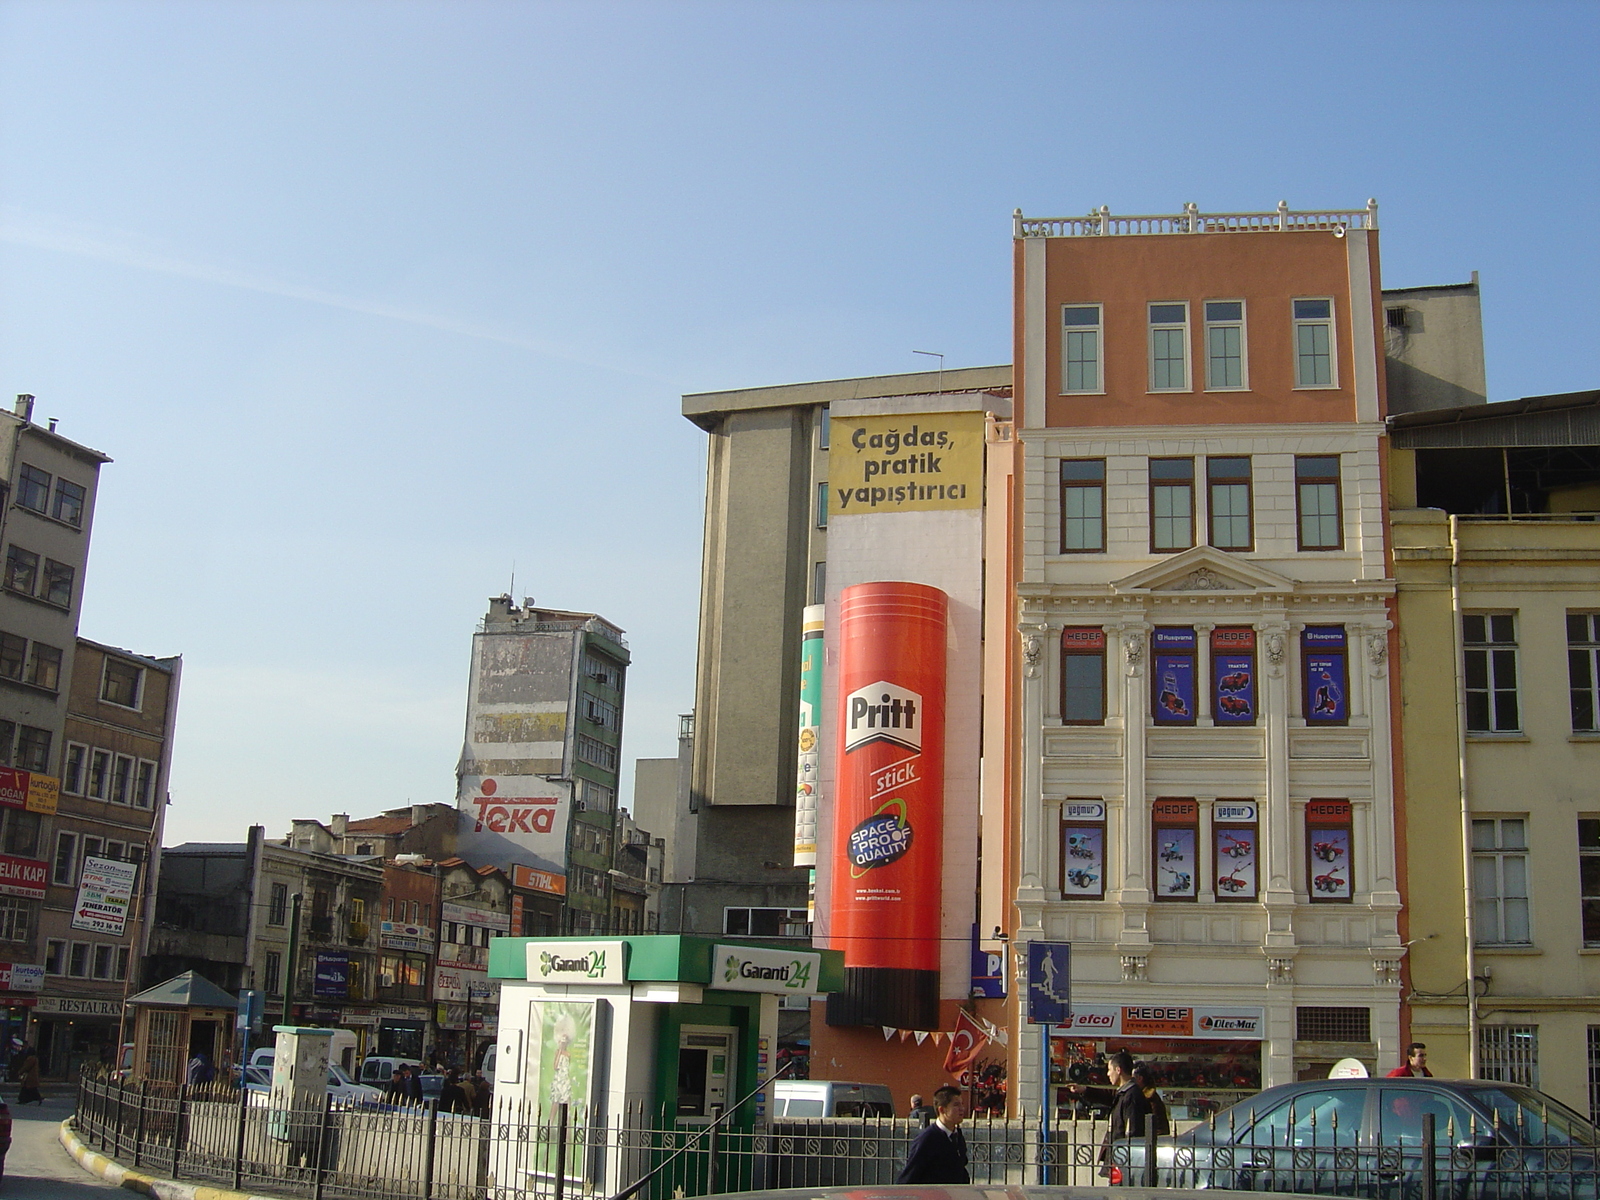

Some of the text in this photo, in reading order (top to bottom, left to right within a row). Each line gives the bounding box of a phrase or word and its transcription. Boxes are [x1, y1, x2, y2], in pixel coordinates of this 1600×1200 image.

[851, 425, 954, 455] Çağdaş,
[864, 452, 942, 482] pratik
[837, 481, 966, 508] yapıştırıcı
[1067, 632, 1101, 640] HEDEF
[1216, 632, 1251, 640] HEDEF
[851, 693, 916, 730] Pritt
[876, 763, 916, 793] stick
[30, 777, 59, 793] kurtoğlu
[0, 787, 25, 800] OĞAN
[1156, 804, 1194, 815] HEDEF
[1311, 805, 1349, 815] HEDEF
[851, 820, 896, 844] SPACE
[856, 839, 907, 865] QUALITY
[86, 859, 116, 872] Sezon
[23, 865, 47, 883] KAPI
[83, 873, 104, 882] STIHL
[528, 872, 553, 890] STIHL
[86, 890, 102, 898] SBM
[82, 902, 122, 914] JENERATÖR
[92, 920, 104, 928] 293
[551, 950, 606, 978] Garanti 24
[987, 954, 1003, 977] P
[15, 966, 44, 976] kurtoğlu
[741, 960, 811, 988] Garanti 24
[1079, 1014, 1110, 1025] efco
[1127, 1007, 1188, 1020] HEDEF
[1214, 1019, 1257, 1029] Oleo-Mac
